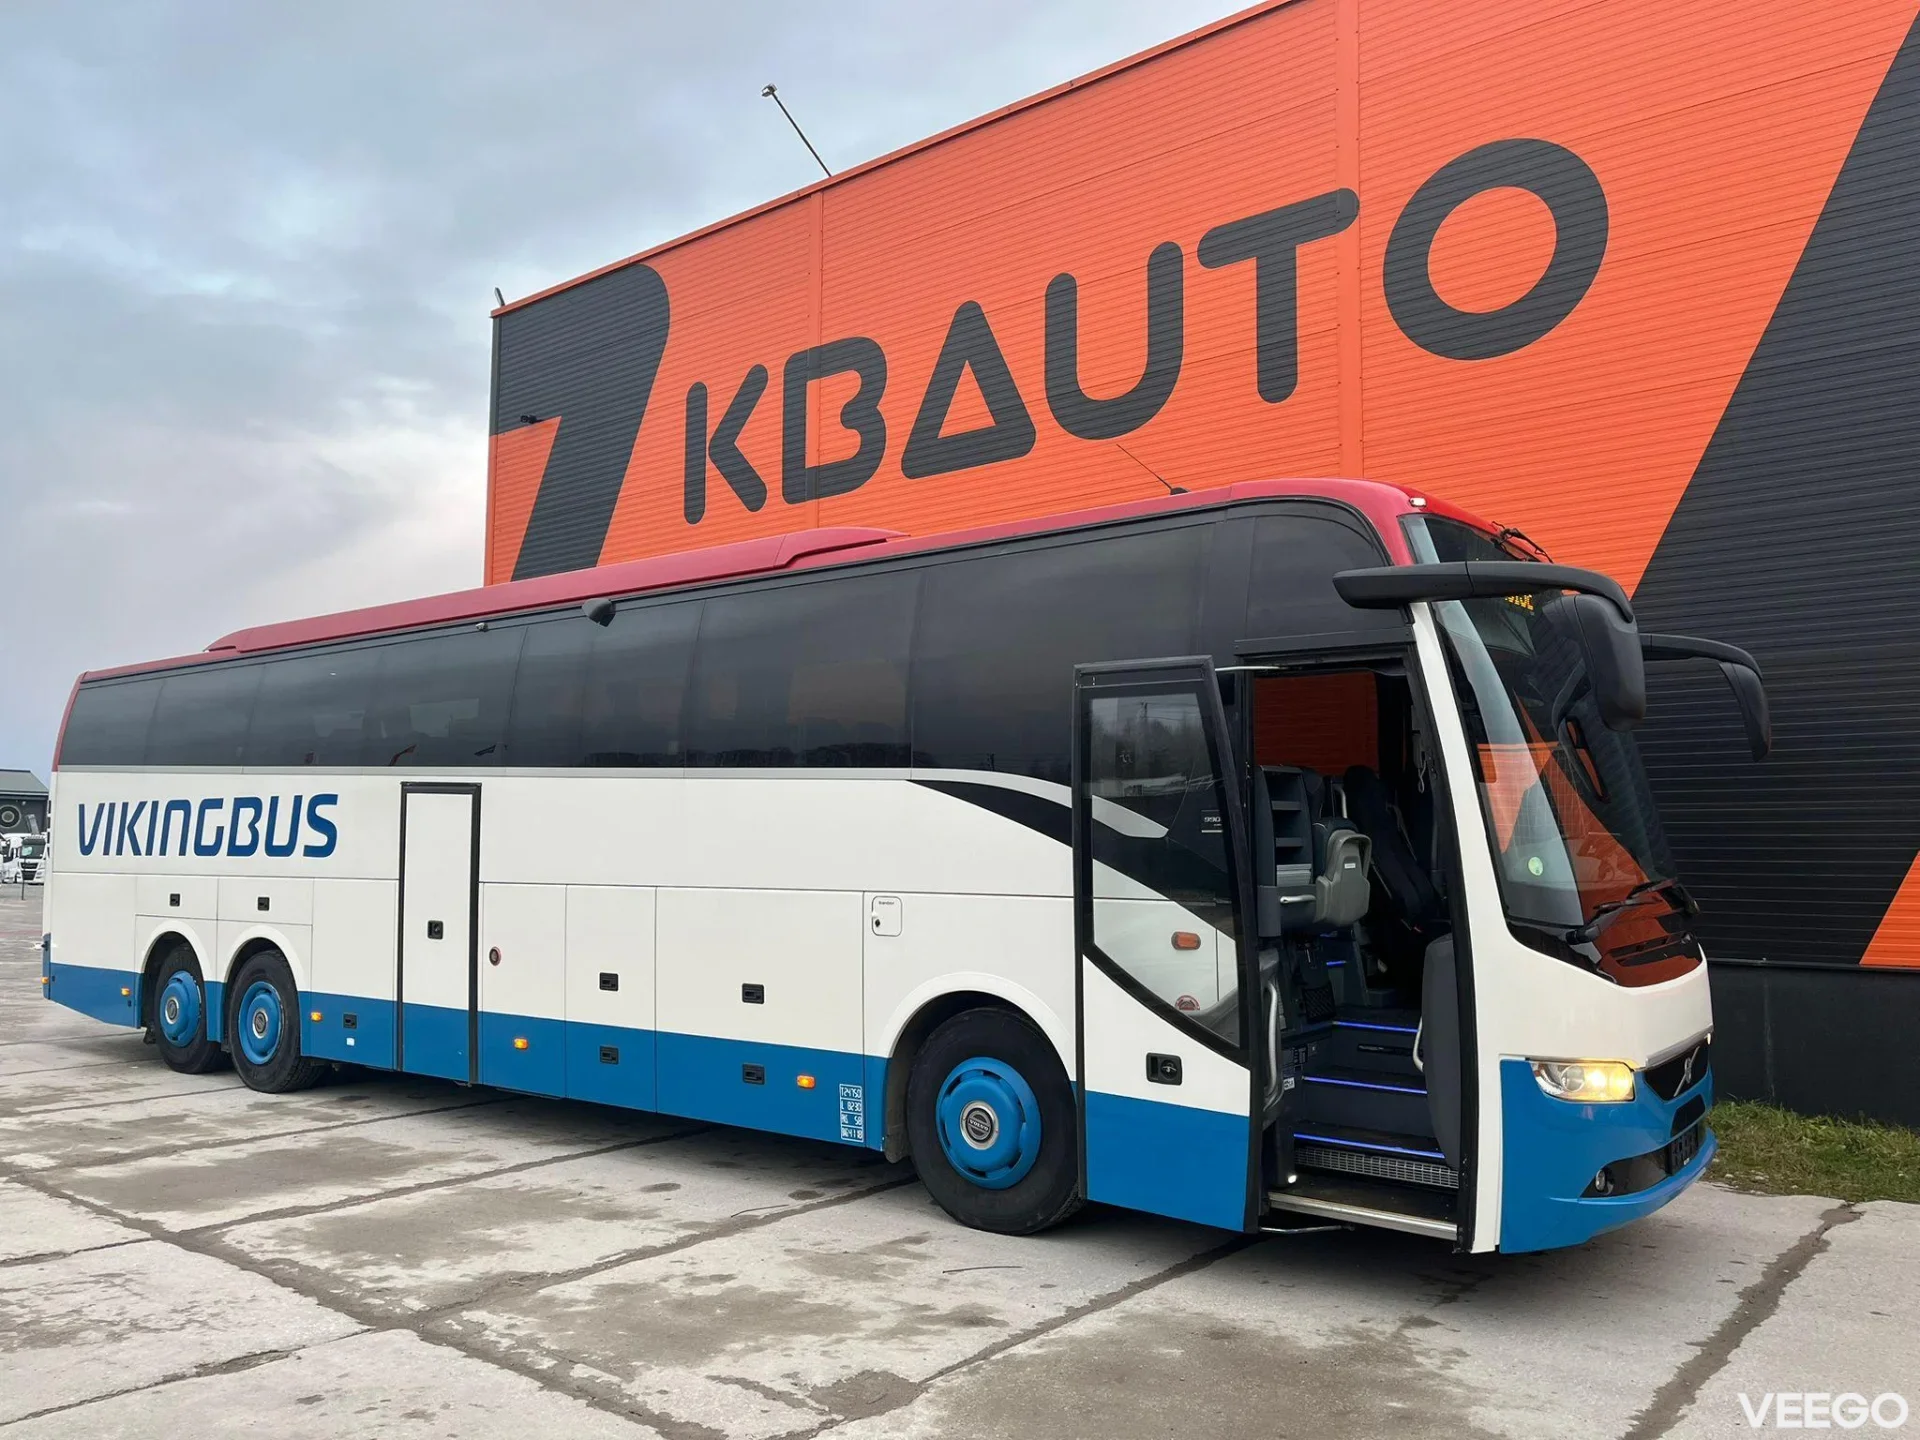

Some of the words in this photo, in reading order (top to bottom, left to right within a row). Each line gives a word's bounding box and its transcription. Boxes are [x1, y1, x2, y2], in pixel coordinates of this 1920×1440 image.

[684, 137, 1609, 524] KBAUTO
[78, 794, 338, 858] VIKINGBUS
[970, 1119, 989, 1131] VOLVO
